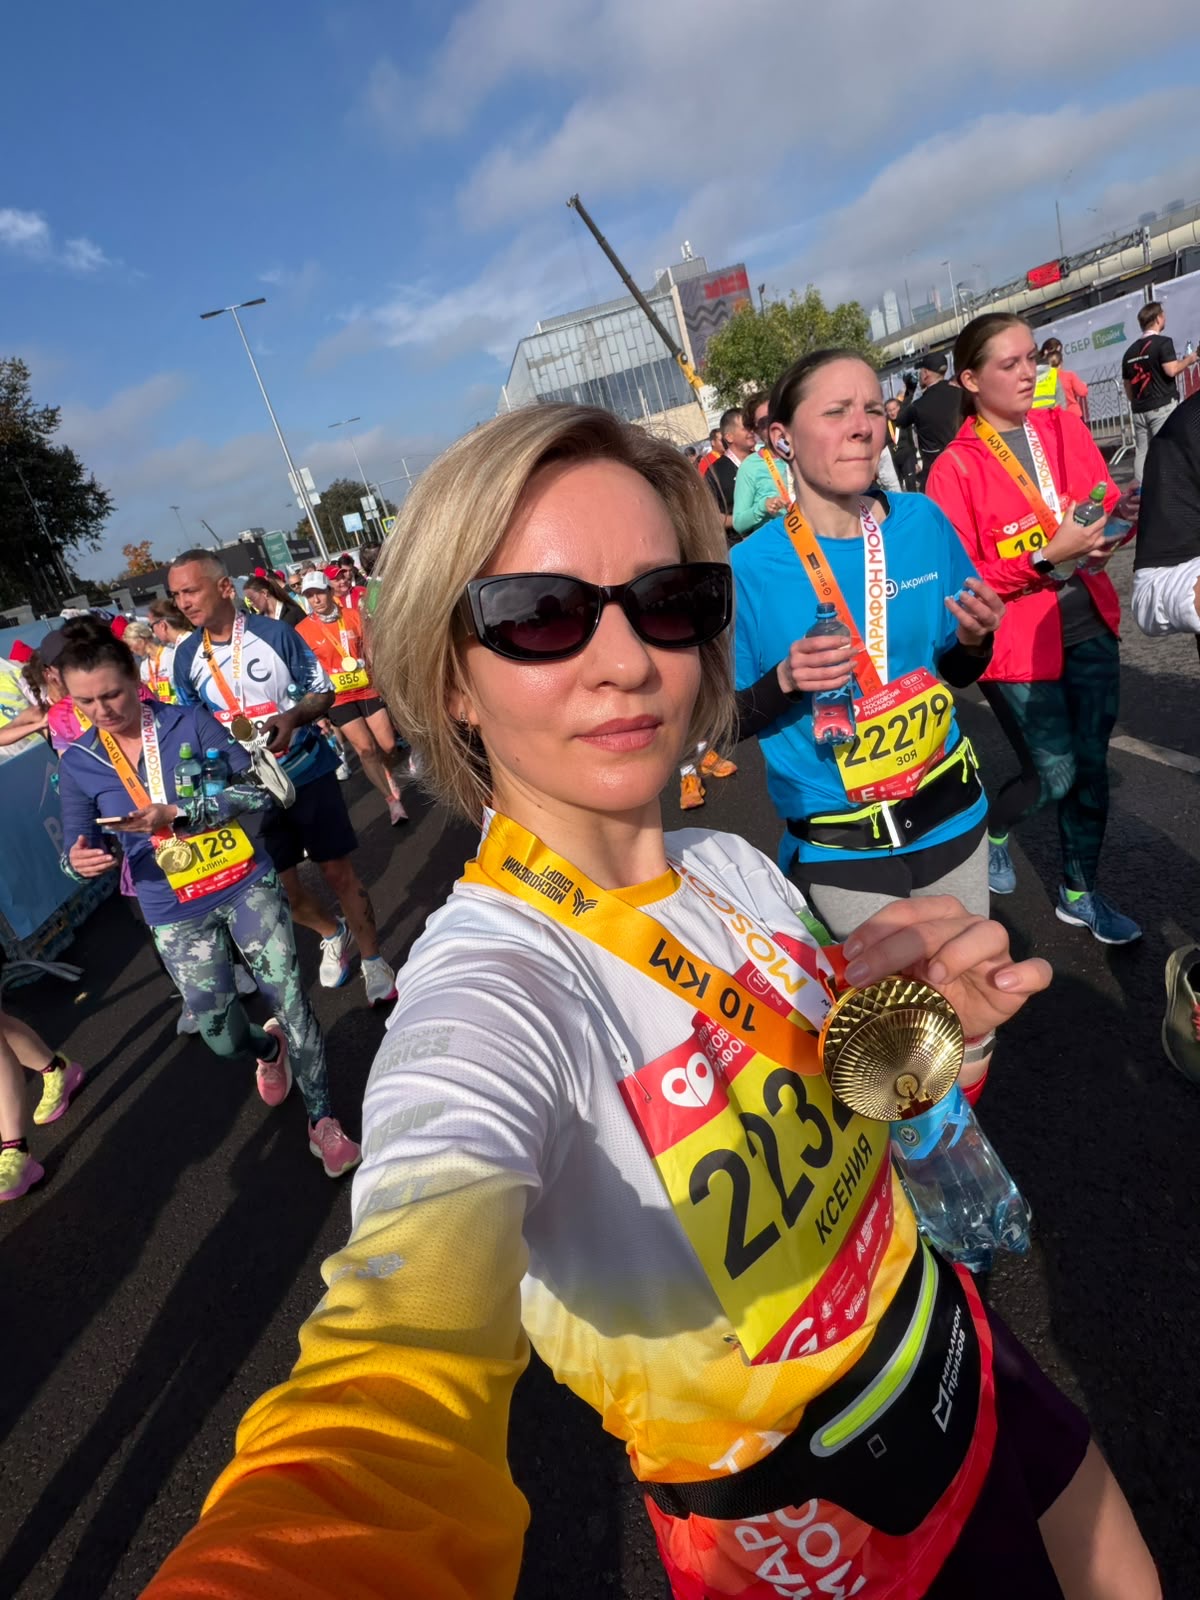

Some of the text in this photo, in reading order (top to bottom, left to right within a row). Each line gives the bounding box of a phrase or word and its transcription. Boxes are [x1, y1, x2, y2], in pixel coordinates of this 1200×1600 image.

[1064, 338, 1091, 356] СБЕР
[998, 449, 1011, 463] 10
[1030, 440, 1051, 489] MOSCOW
[787, 515, 803, 534] 10
[1013, 531, 1047, 552] 19
[868, 567, 884, 668] МАРАФОН
[232, 633, 244, 679] МАРАФОН
[338, 673, 361, 686] 856
[843, 692, 951, 769] 22279
[112, 751, 122, 764] 10
[146, 747, 162, 796] MOSCOW
[896, 749, 919, 767] ЗОЯ
[196, 856, 229, 875] ГАЛИНА
[501, 854, 568, 906] МОСКОВСКИЙ
[538, 864, 575, 895] СПОРТ
[184, 885, 196, 899] F
[648, 937, 712, 999] KM
[719, 986, 756, 1032] 10
[688, 1067, 856, 1280] 223
[814, 1133, 874, 1246] КСЕНИЯ
[941, 1304, 962, 1384] МИЛЛИОН
